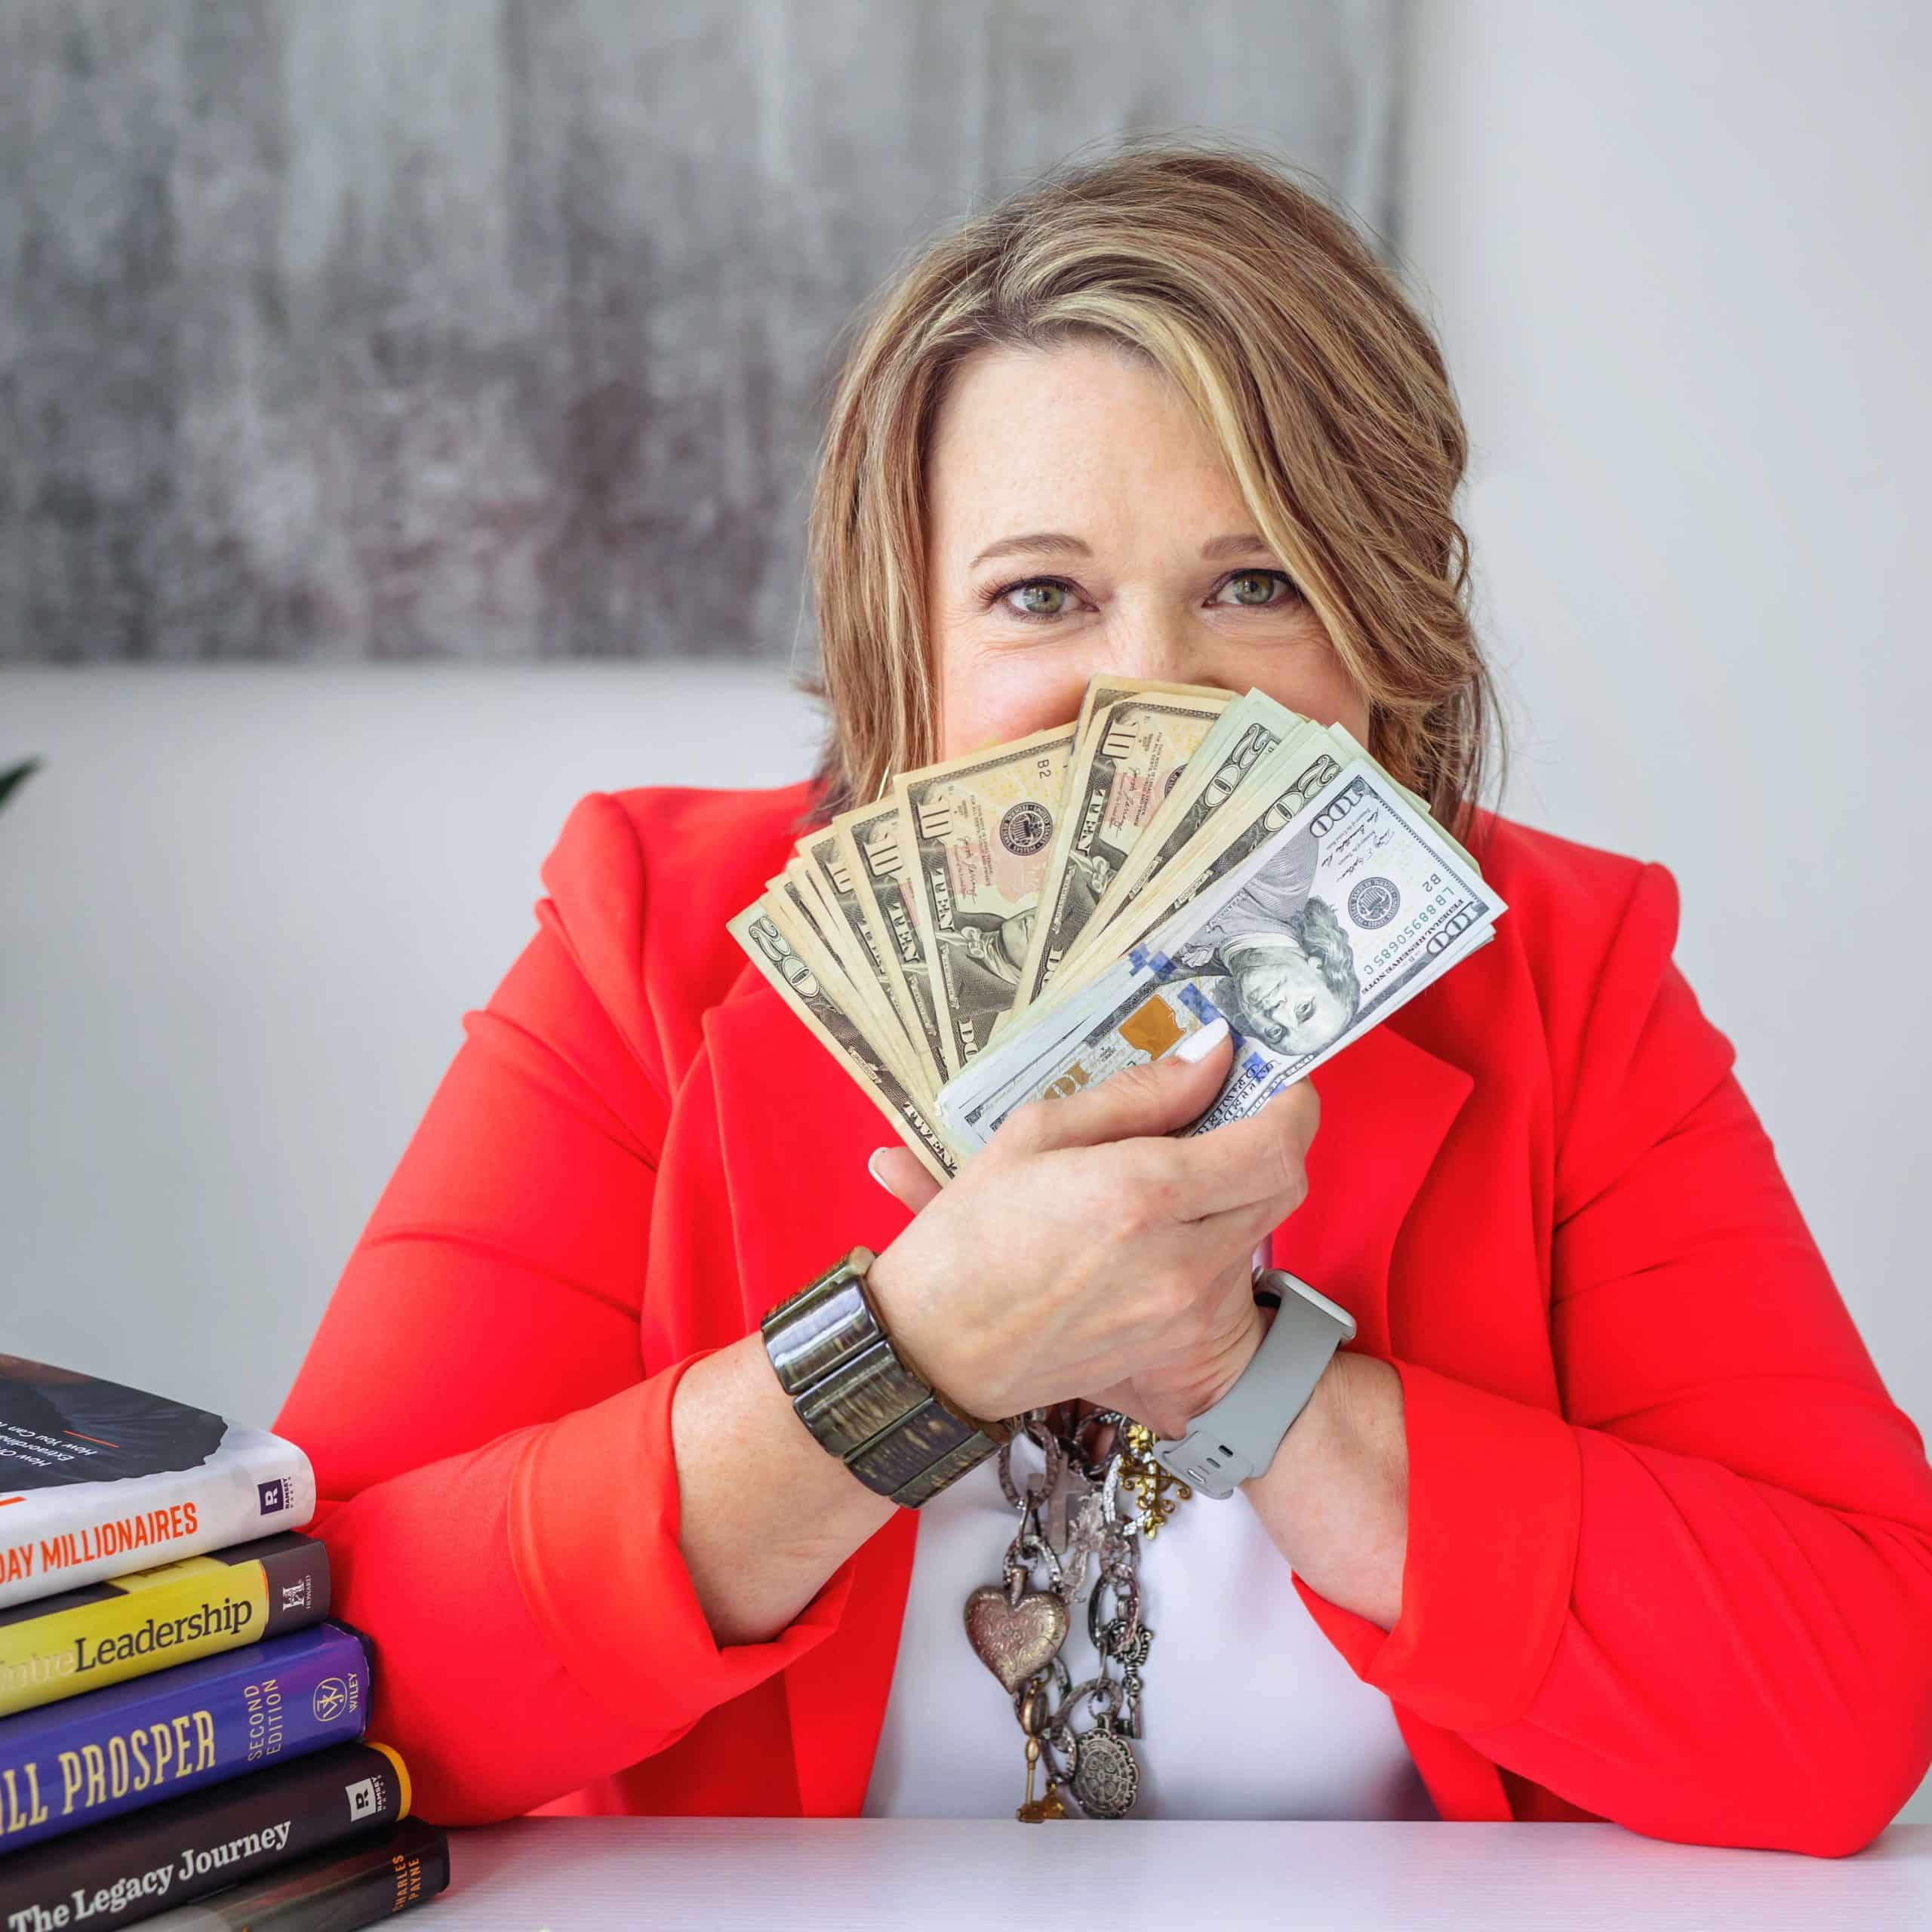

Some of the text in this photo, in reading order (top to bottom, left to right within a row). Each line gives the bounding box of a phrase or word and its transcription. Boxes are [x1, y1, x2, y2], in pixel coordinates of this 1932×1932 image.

[1100, 721, 1139, 759] 10
[1037, 759, 1051, 780] B2
[1204, 723, 1269, 807] 20
[1263, 755, 1340, 832] 20
[1310, 788, 1364, 838] 100
[917, 795, 954, 839] 10
[863, 832, 904, 876] 10
[930, 868, 955, 930] TEN
[1422, 873, 1441, 893] B2
[888, 903, 920, 963] TEN
[1425, 899, 1464, 935] FEDERAL
[1426, 901, 1479, 956] 100
[748, 916, 821, 998] 20
[1386, 935, 1426, 974] RESERVE
[1361, 973, 1386, 995] NOTE
[8, 1426, 97, 1456] How You Can
[15, 1454, 52, 1466] How
[40, 1502, 198, 1574] MILLIONAIRES
[347, 1672, 359, 1714] WILEY
[244, 1685, 265, 1761] SECOND
[262, 1678, 283, 1756] EDITION
[58, 1710, 216, 1816] PROSPER
[371, 1776, 383, 1813] RAMSEY
[8, 1820, 292, 1932] The Legacy Journey
[408, 1857, 422, 1901] PAYNE
